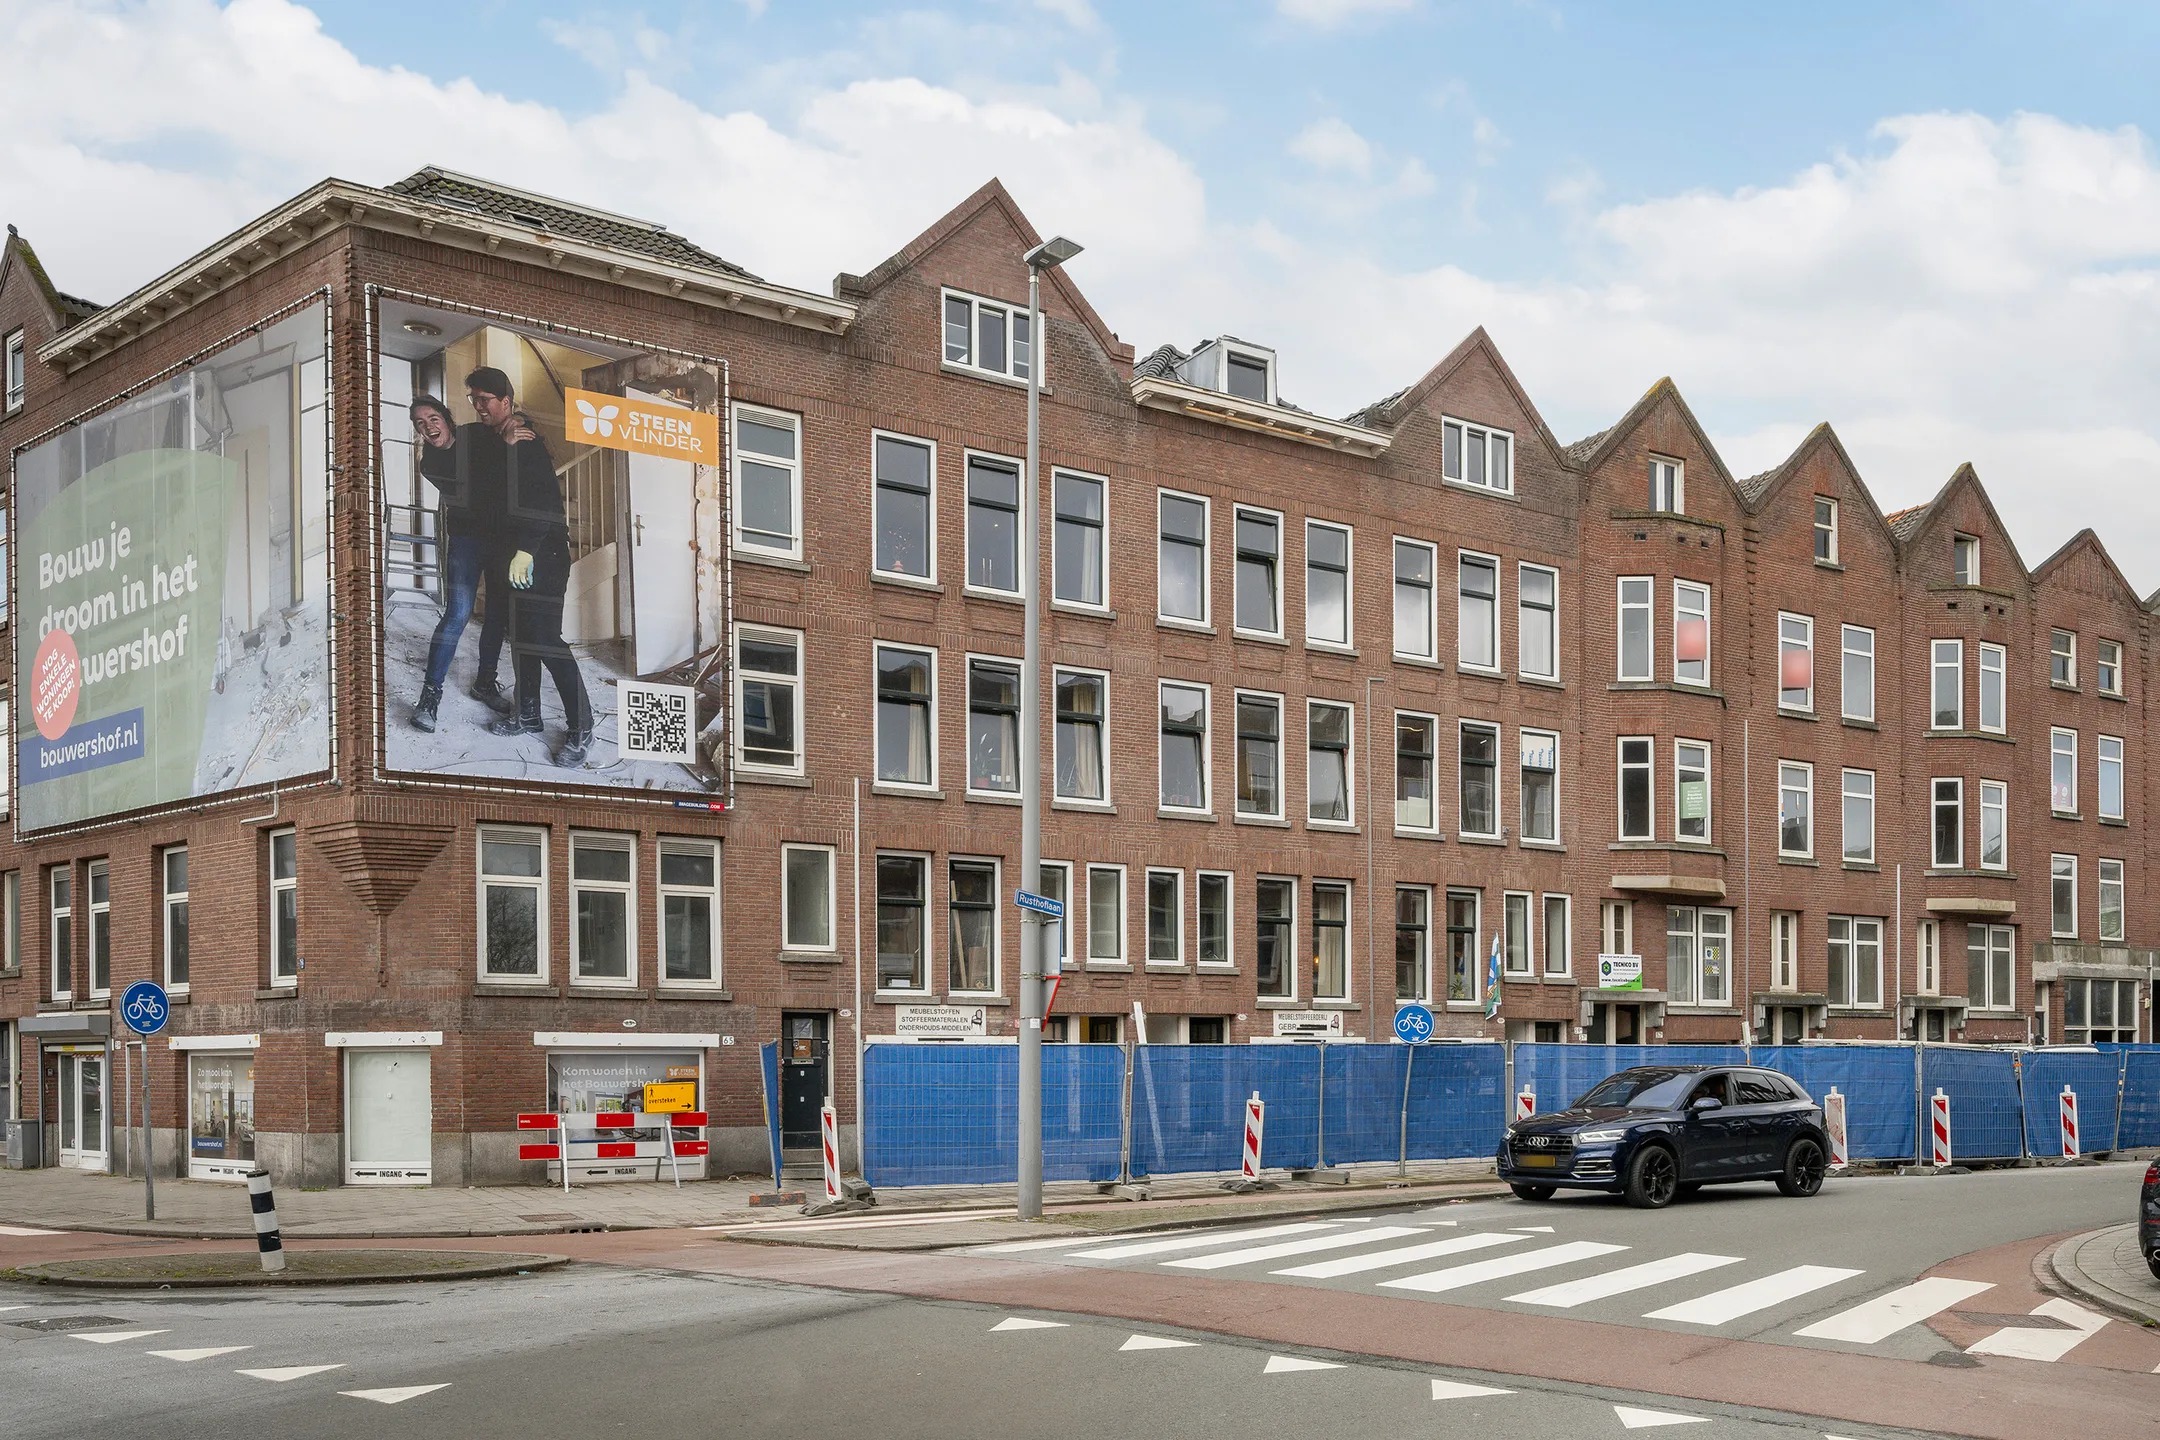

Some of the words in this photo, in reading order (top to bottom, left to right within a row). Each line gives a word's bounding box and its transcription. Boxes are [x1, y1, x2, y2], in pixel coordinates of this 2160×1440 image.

[618, 424, 703, 453] VLINDER
[628, 411, 692, 435] STEEN
[39, 537, 104, 590] Bouw
[110, 521, 131, 571] je
[39, 591, 117, 643] droom
[122, 574, 147, 615] in
[152, 554, 198, 605] het
[42, 648, 58, 674] NOG
[79, 614, 188, 687] wershof
[36, 659, 76, 715] WONINGEN
[39, 654, 68, 695] ENKELE
[43, 707, 53, 723] TE
[53, 678, 75, 713] KOOP!
[40, 722, 138, 768] bouwershof.nl
[1019, 893, 1061, 912] Rusthoflaan
[562, 1066, 590, 1076] Kom
[591, 1067, 633, 1075] wonen
[635, 1066, 647, 1075] in
[562, 1080, 583, 1089] het
